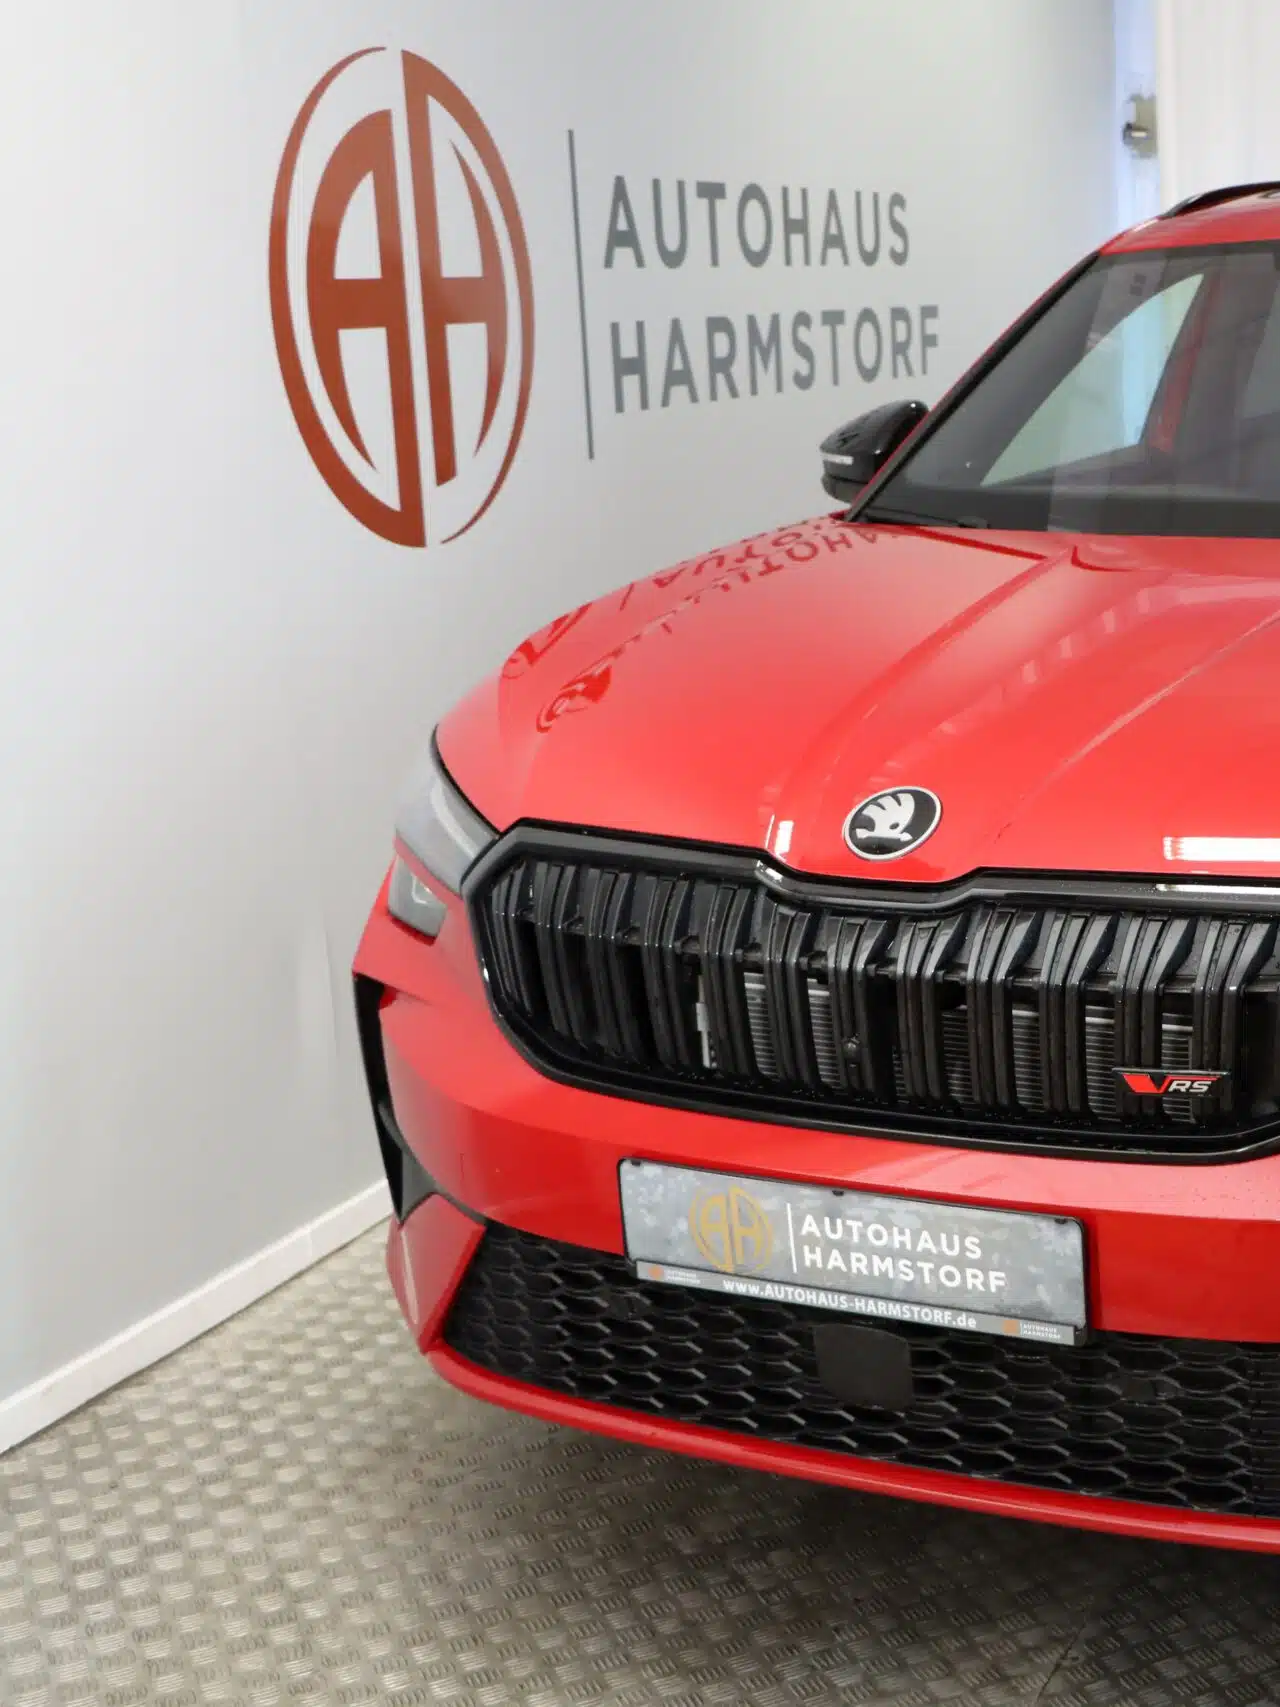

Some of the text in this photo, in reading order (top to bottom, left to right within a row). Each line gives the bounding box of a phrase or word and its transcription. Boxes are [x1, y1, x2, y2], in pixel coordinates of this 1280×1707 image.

[603, 174, 911, 270] AUTOHAUS
[609, 304, 941, 414] HARMSTORF
[800, 1213, 982, 1260] AUTOHAUS
[803, 1244, 1007, 1294] HARMSTORF
[722, 1279, 977, 1329] www.AUTOHAUS-HARMSTORF.de
